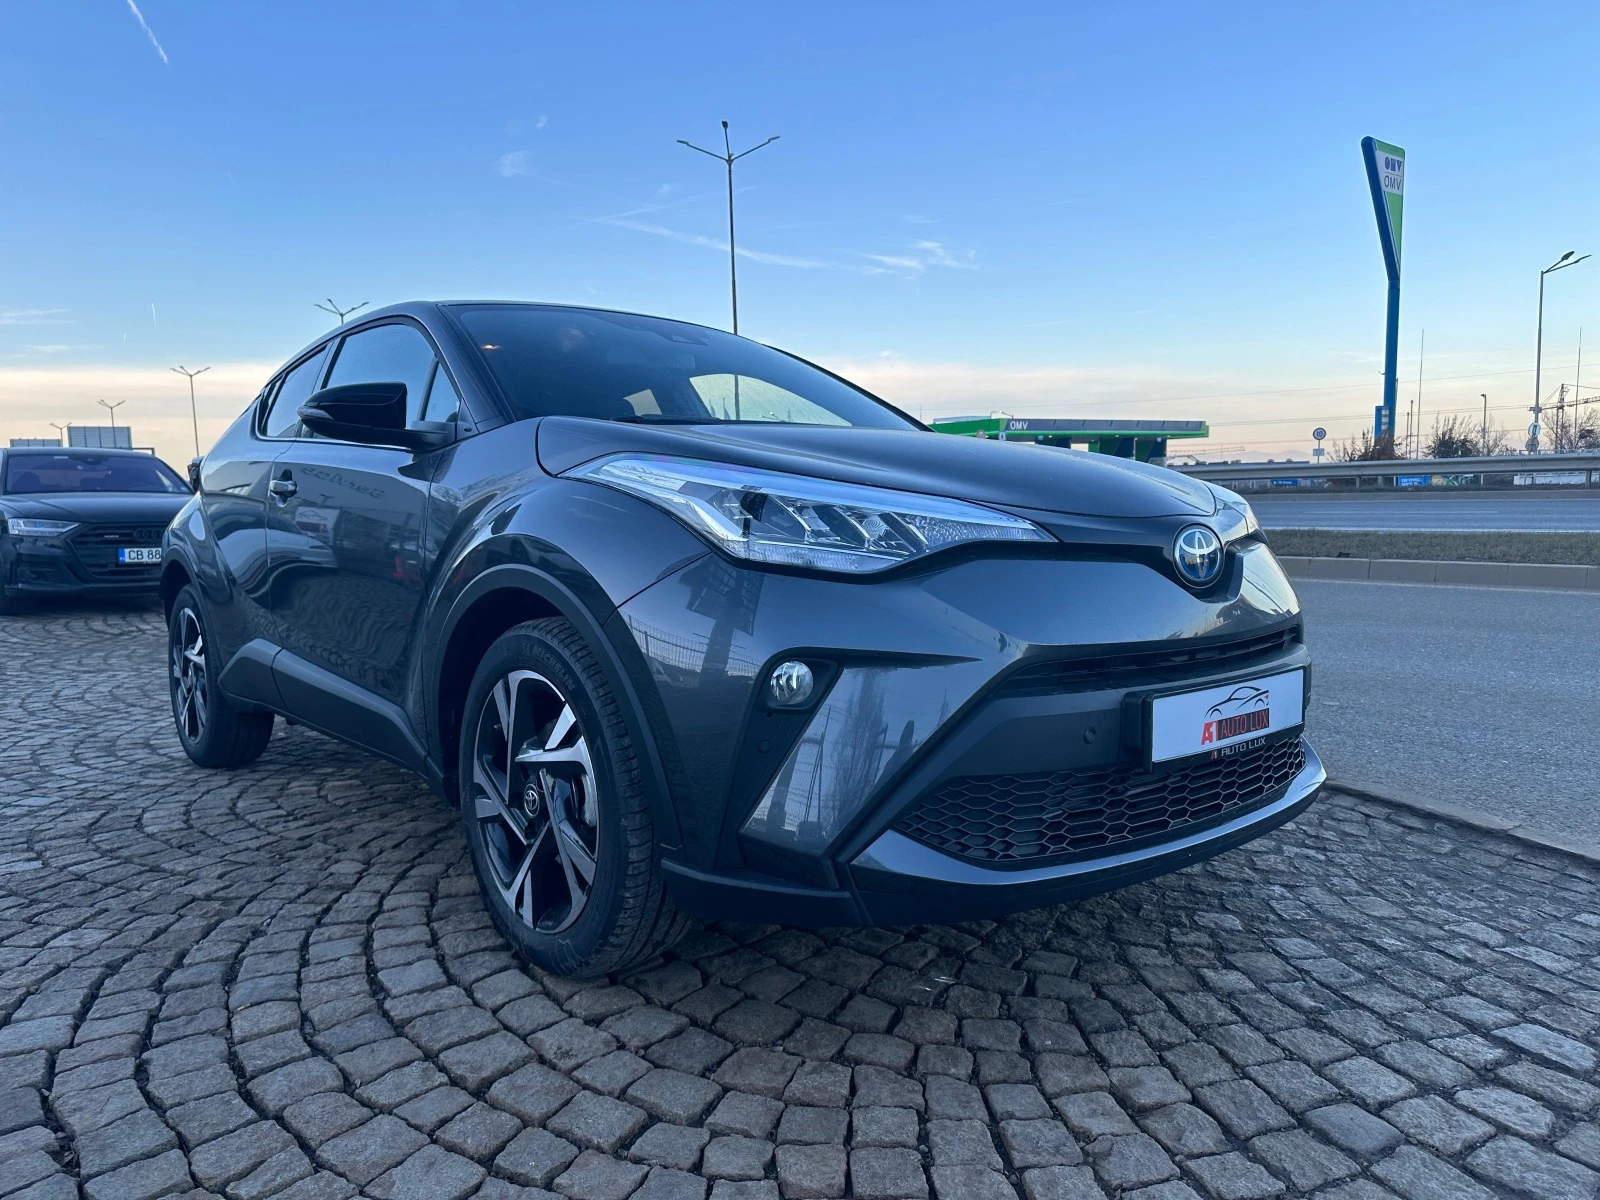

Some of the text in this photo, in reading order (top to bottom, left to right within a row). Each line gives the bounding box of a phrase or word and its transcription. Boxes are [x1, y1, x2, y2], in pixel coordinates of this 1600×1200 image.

[1384, 156, 1402, 172] OMV
[1384, 175, 1401, 190] OMV
[1009, 421, 1029, 430] OMV
[128, 549, 161, 560] CB 88
[531, 646, 575, 692] MICHELIN
[1201, 710, 1269, 746] A1 AUTO LUX
[1221, 744, 1246, 757] AUTO
[1249, 737, 1266, 749] LUX
